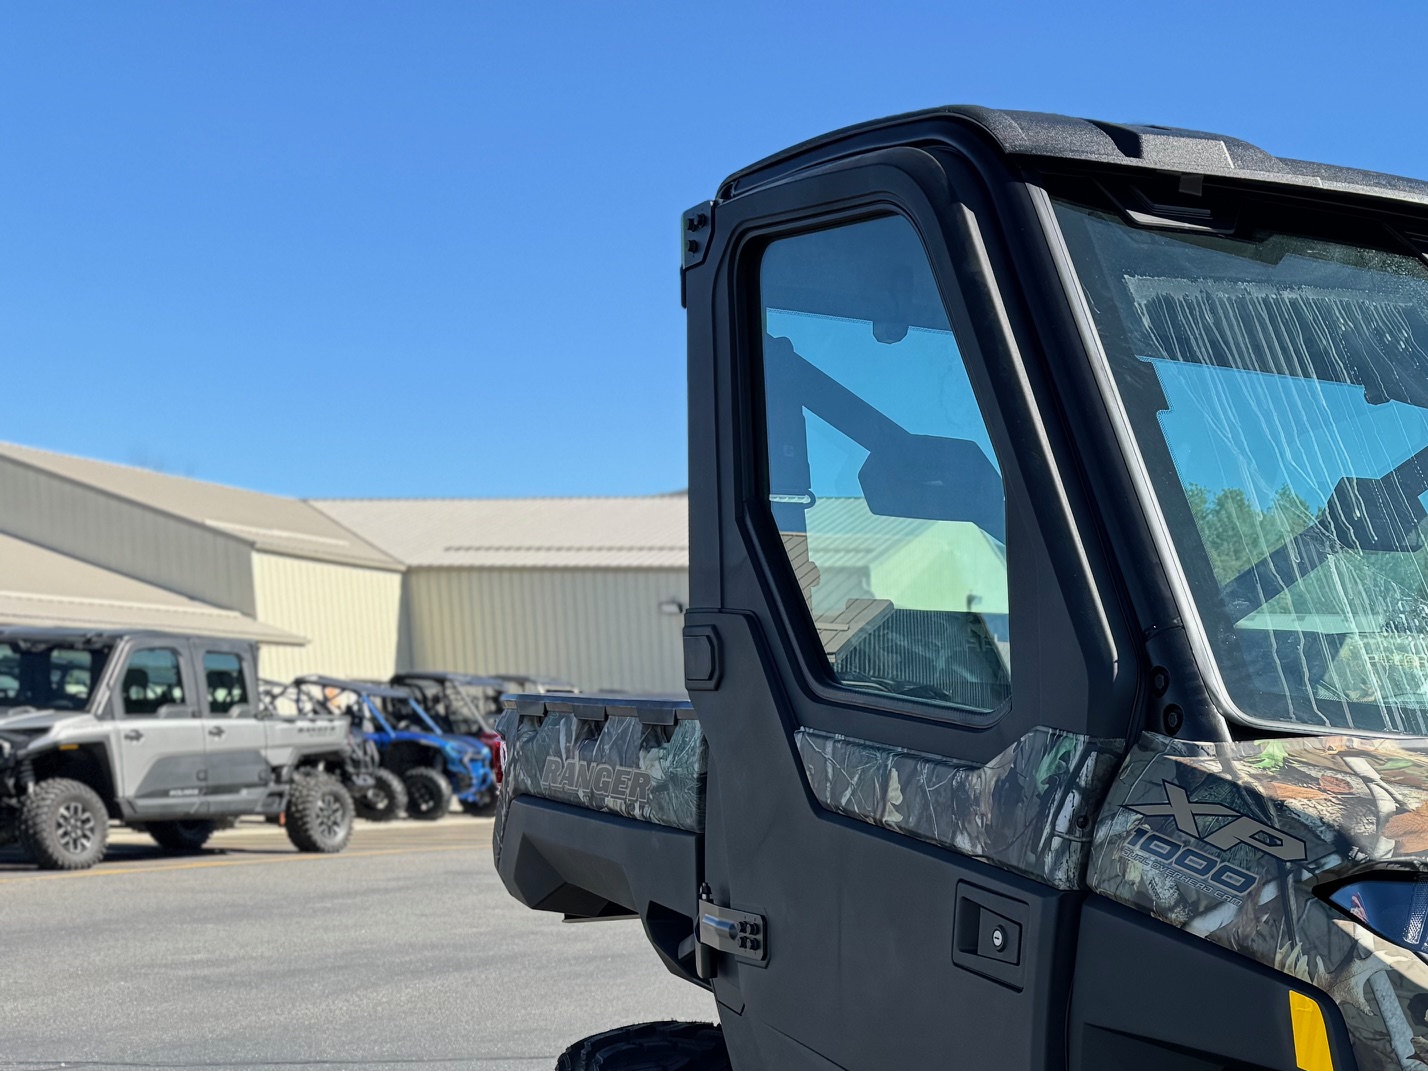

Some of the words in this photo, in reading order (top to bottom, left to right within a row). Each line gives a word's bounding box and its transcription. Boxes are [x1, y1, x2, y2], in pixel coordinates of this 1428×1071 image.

[541, 755, 653, 803] RANGER
[1118, 779, 1307, 861] XP
[1121, 847, 1151, 866] DUAL
[1151, 861, 1216, 894] OVERHEAD
[1214, 889, 1244, 907] CAM
[1124, 826, 1260, 895] 1000
